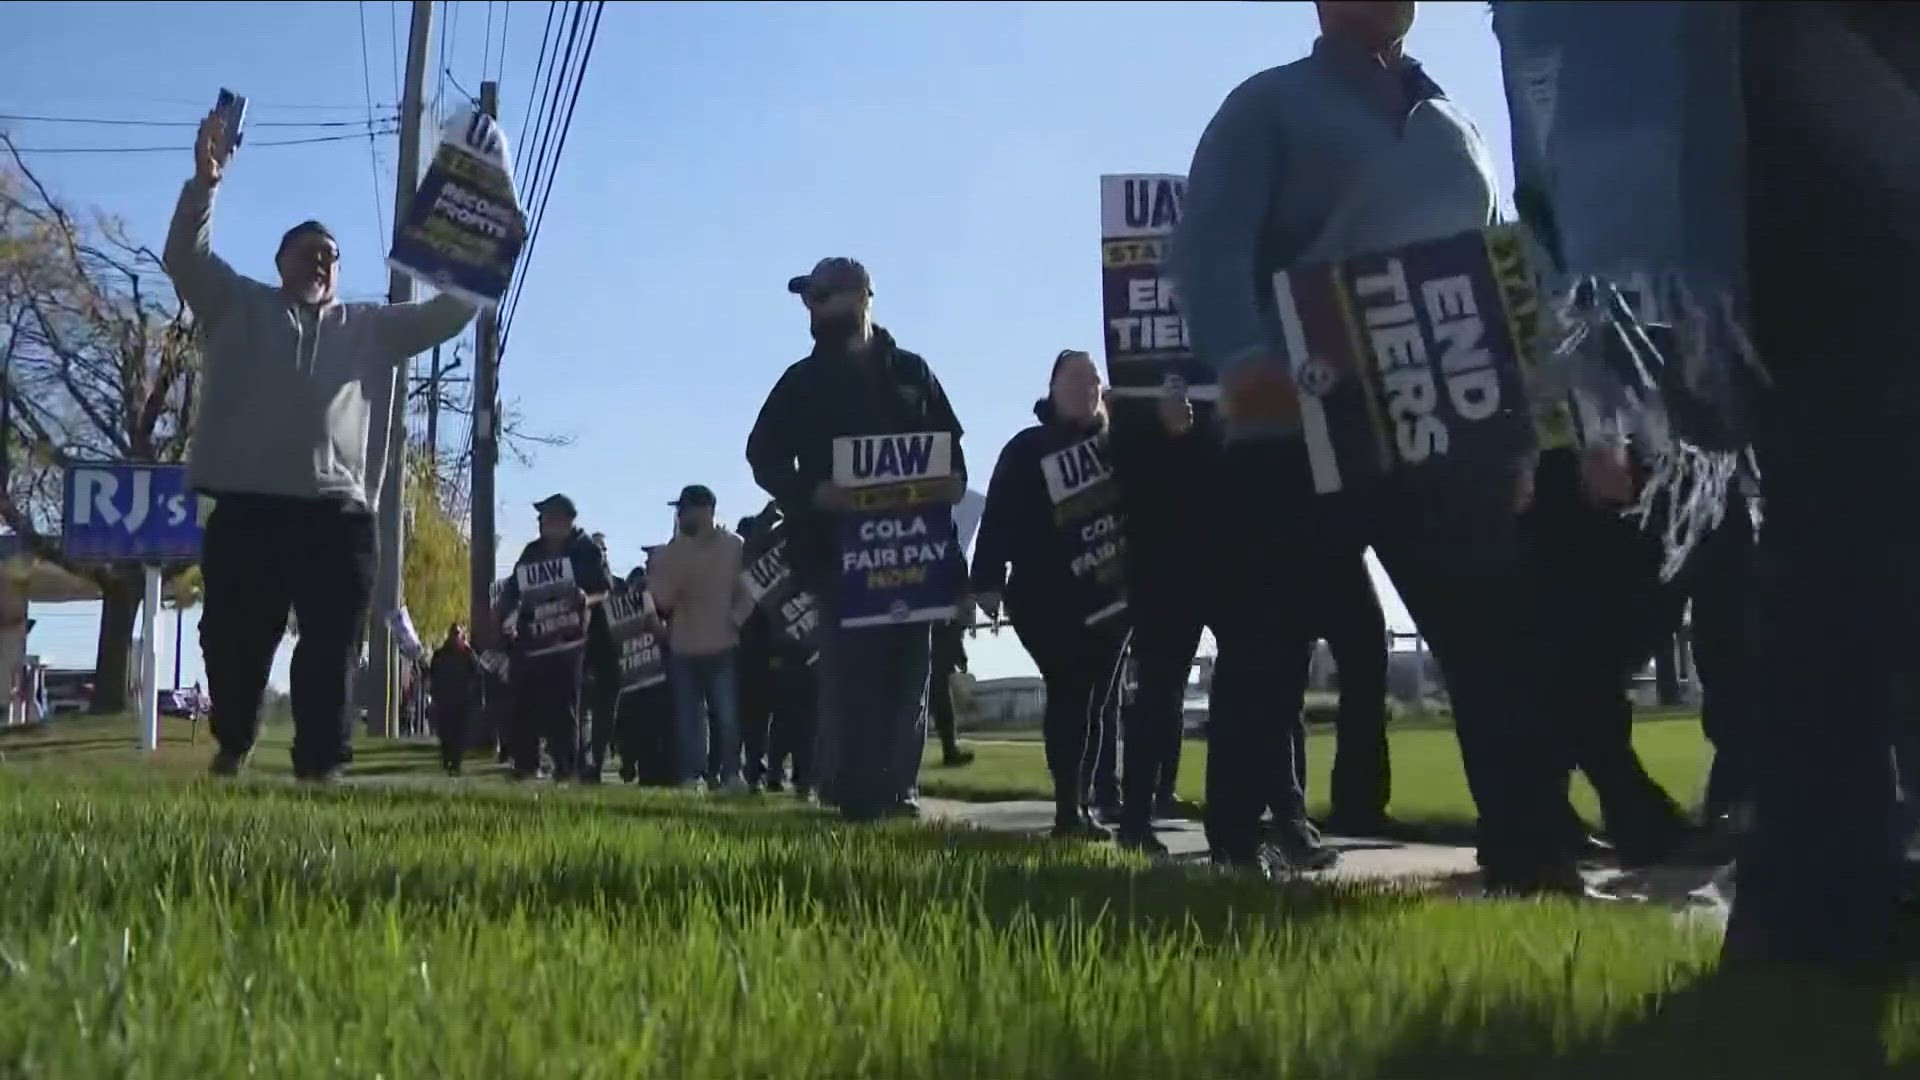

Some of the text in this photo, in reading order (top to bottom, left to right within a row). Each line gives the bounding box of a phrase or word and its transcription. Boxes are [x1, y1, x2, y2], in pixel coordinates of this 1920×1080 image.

[1125, 178, 1185, 228] UA
[1355, 258, 1450, 464] TIERS
[1420, 274, 1501, 421] END
[851, 434, 934, 479] UAW
[73, 468, 188, 535] RJ's
[858, 516, 927, 541] COLA
[526, 556, 565, 586] UAW
[841, 539, 949, 576] FAIR PAY
[610, 588, 645, 621] UAW
[621, 632, 655, 657] END
